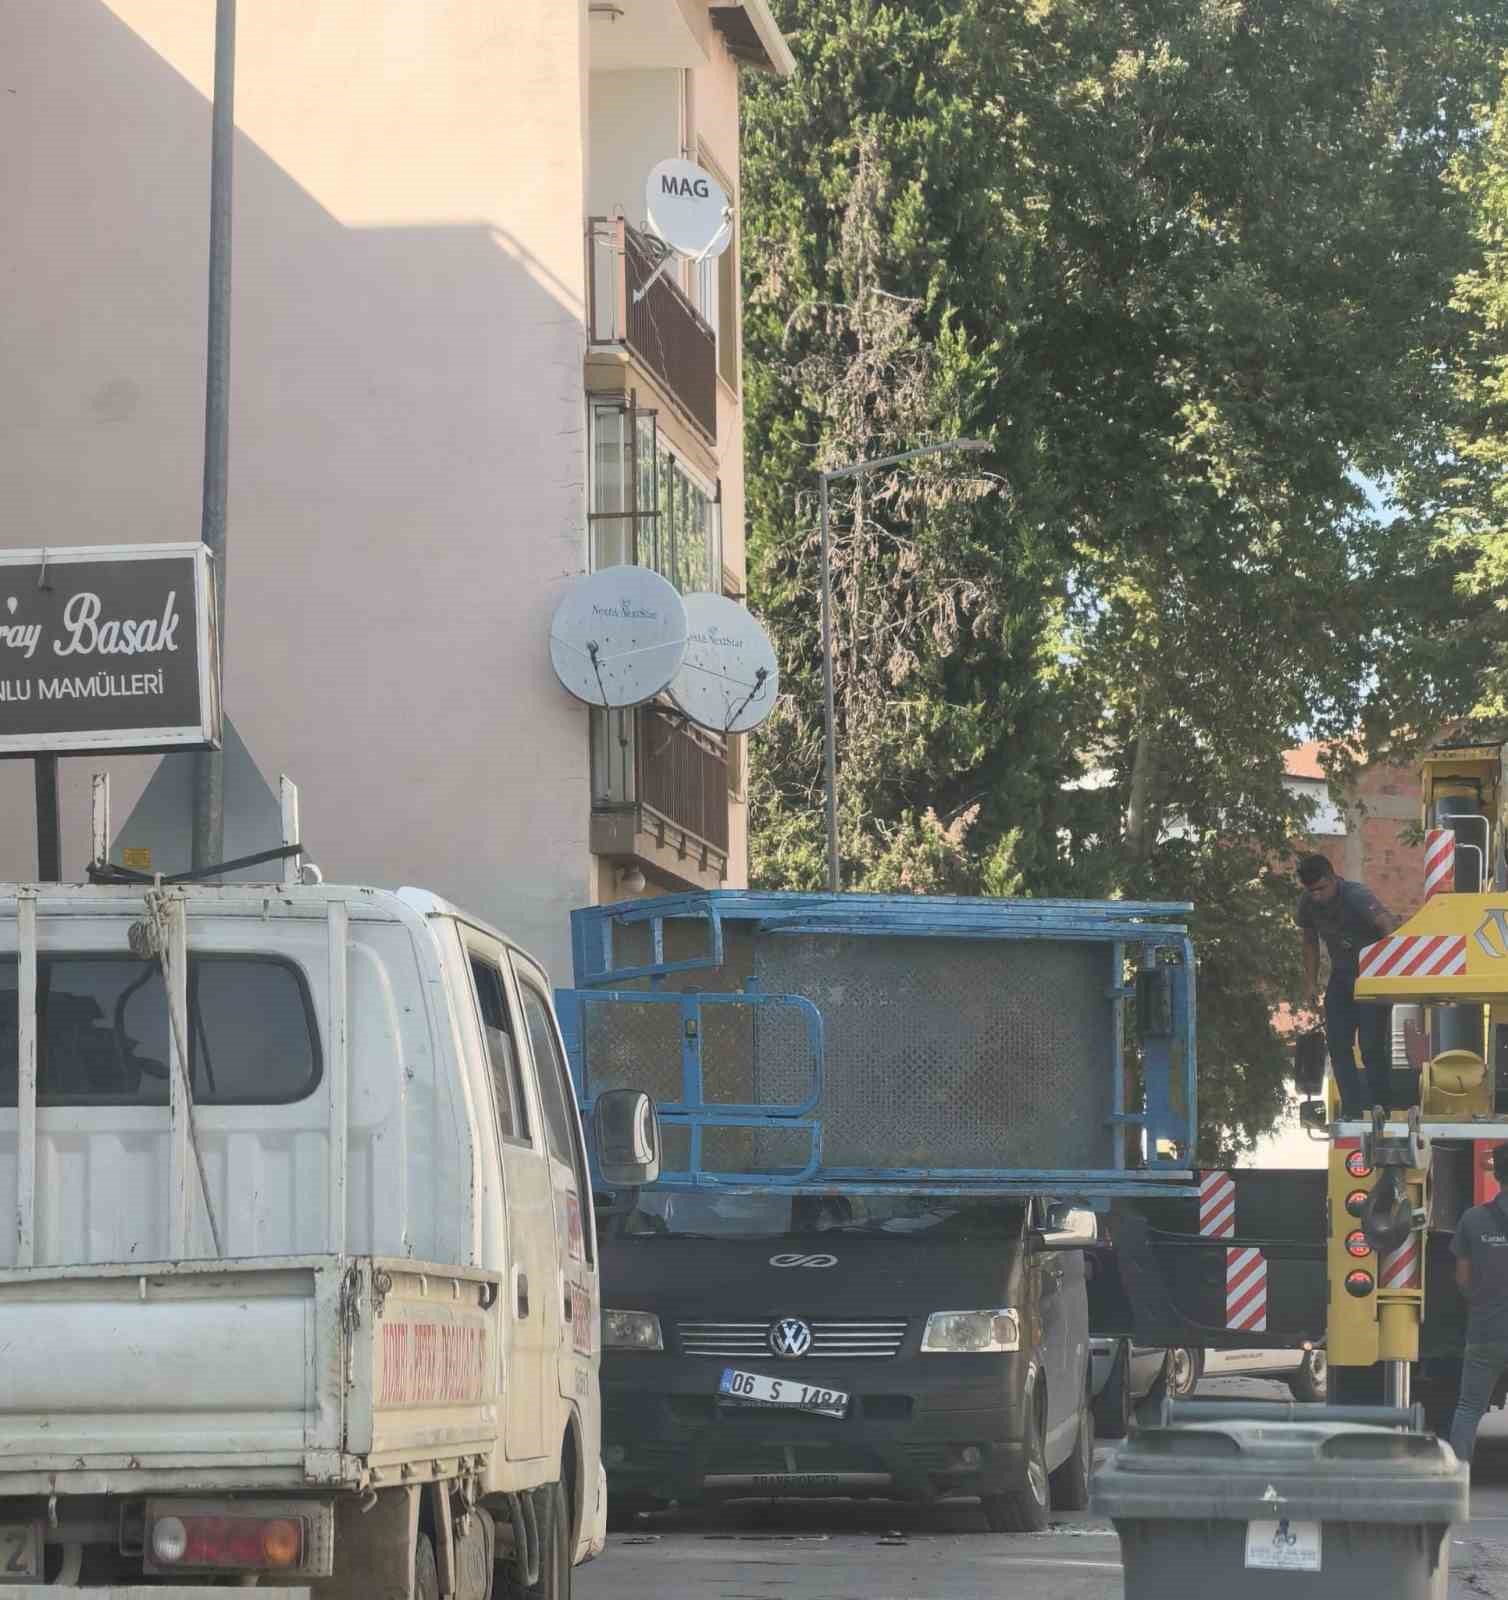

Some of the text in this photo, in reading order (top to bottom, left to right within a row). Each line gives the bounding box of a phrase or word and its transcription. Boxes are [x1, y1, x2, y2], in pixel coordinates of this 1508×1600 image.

[661, 174, 709, 198] MAG
[38, 668, 164, 700] MAMÜLLERİ
[732, 1373, 756, 1395] 06
[769, 1381, 783, 1401] S
